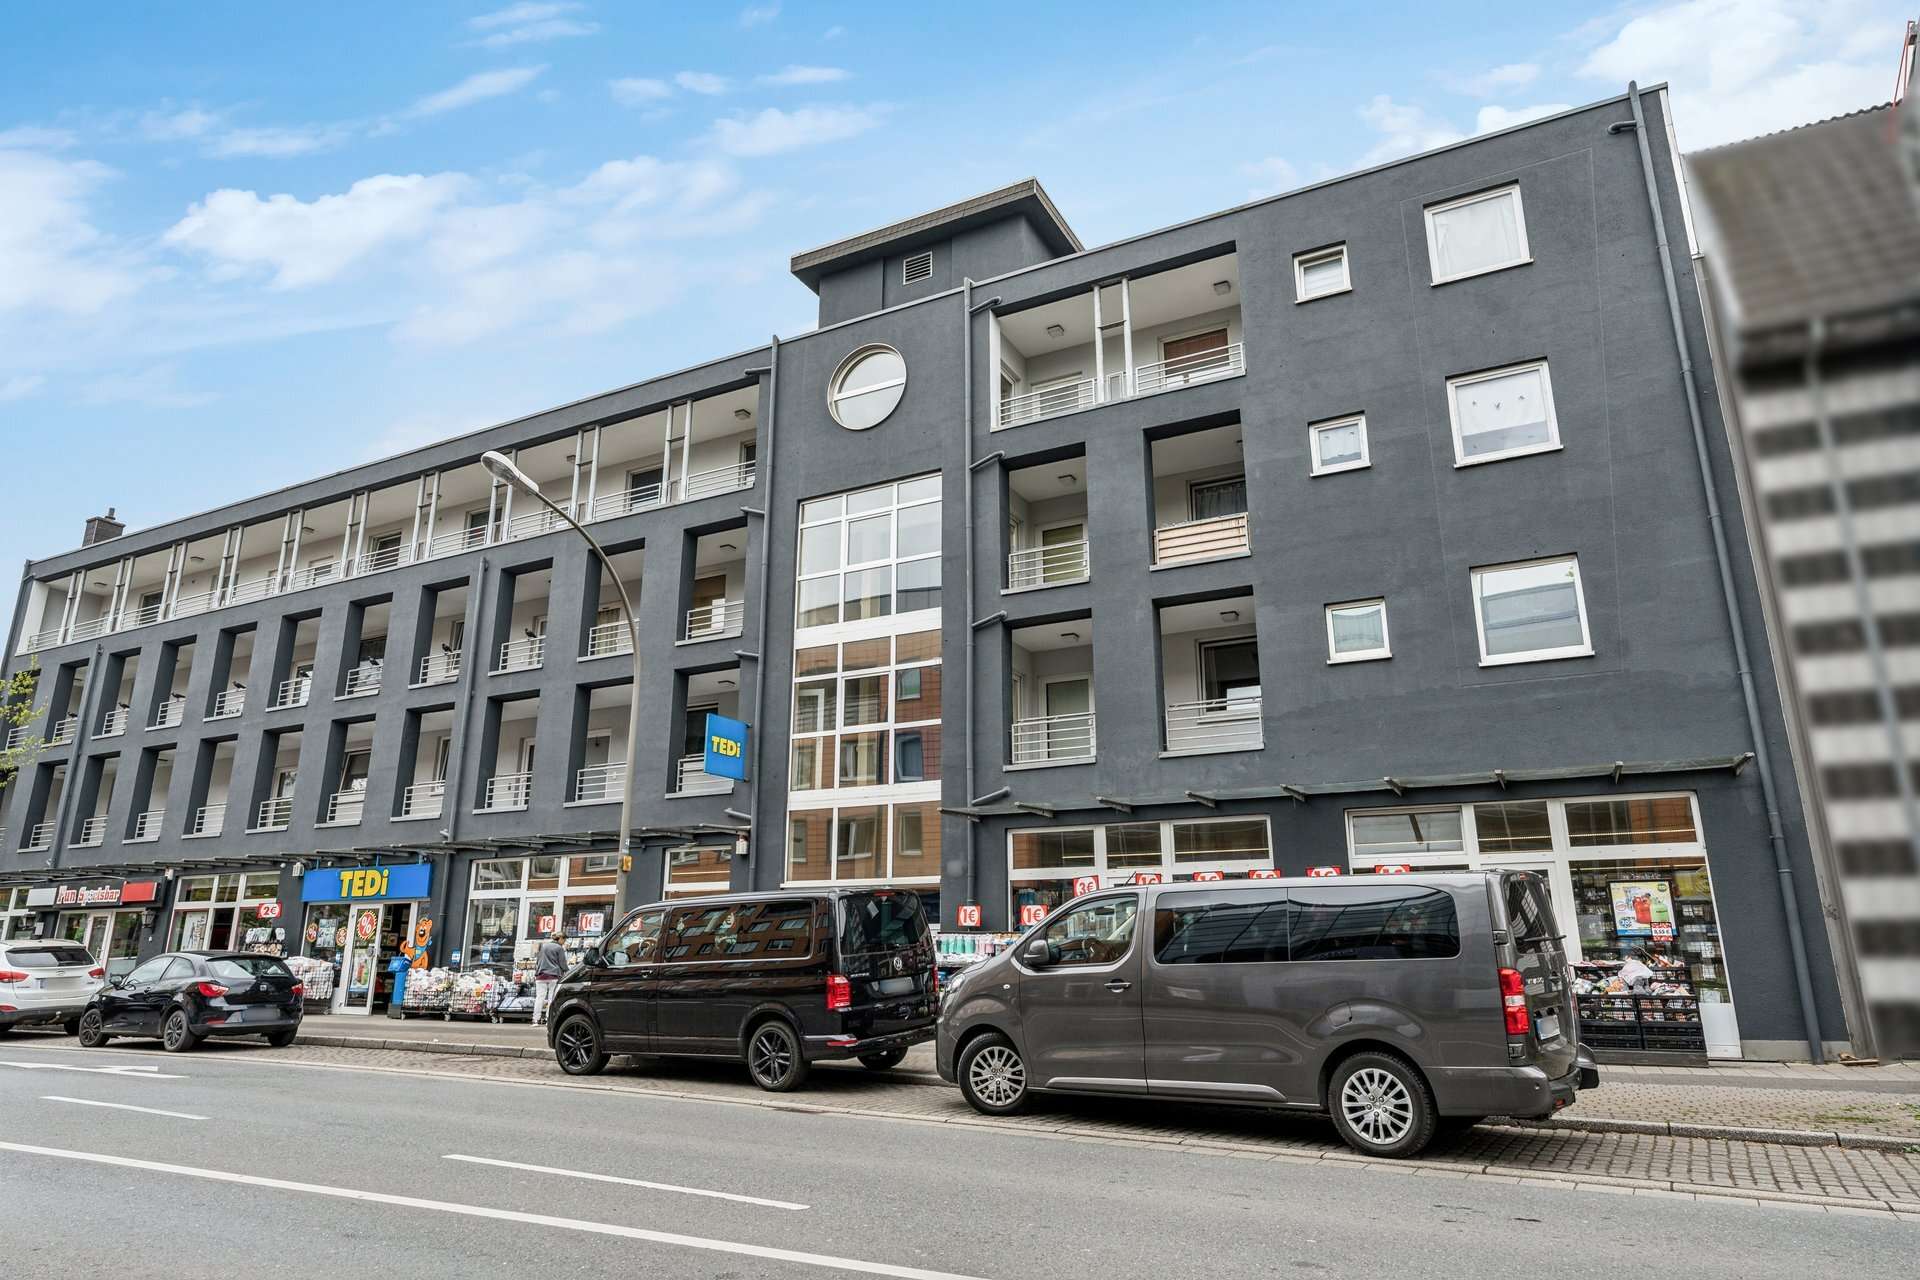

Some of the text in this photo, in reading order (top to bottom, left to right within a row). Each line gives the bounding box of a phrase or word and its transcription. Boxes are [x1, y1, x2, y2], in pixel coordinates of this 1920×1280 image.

[711, 735, 741, 758] TEDi
[340, 869, 389, 897] TEDi
[1079, 881, 1094, 894] 3€
[263, 906, 278, 916] 2€
[963, 908, 976, 923] 1€
[1026, 908, 1042, 921] 1€
[542, 918, 553, 930] 1€
